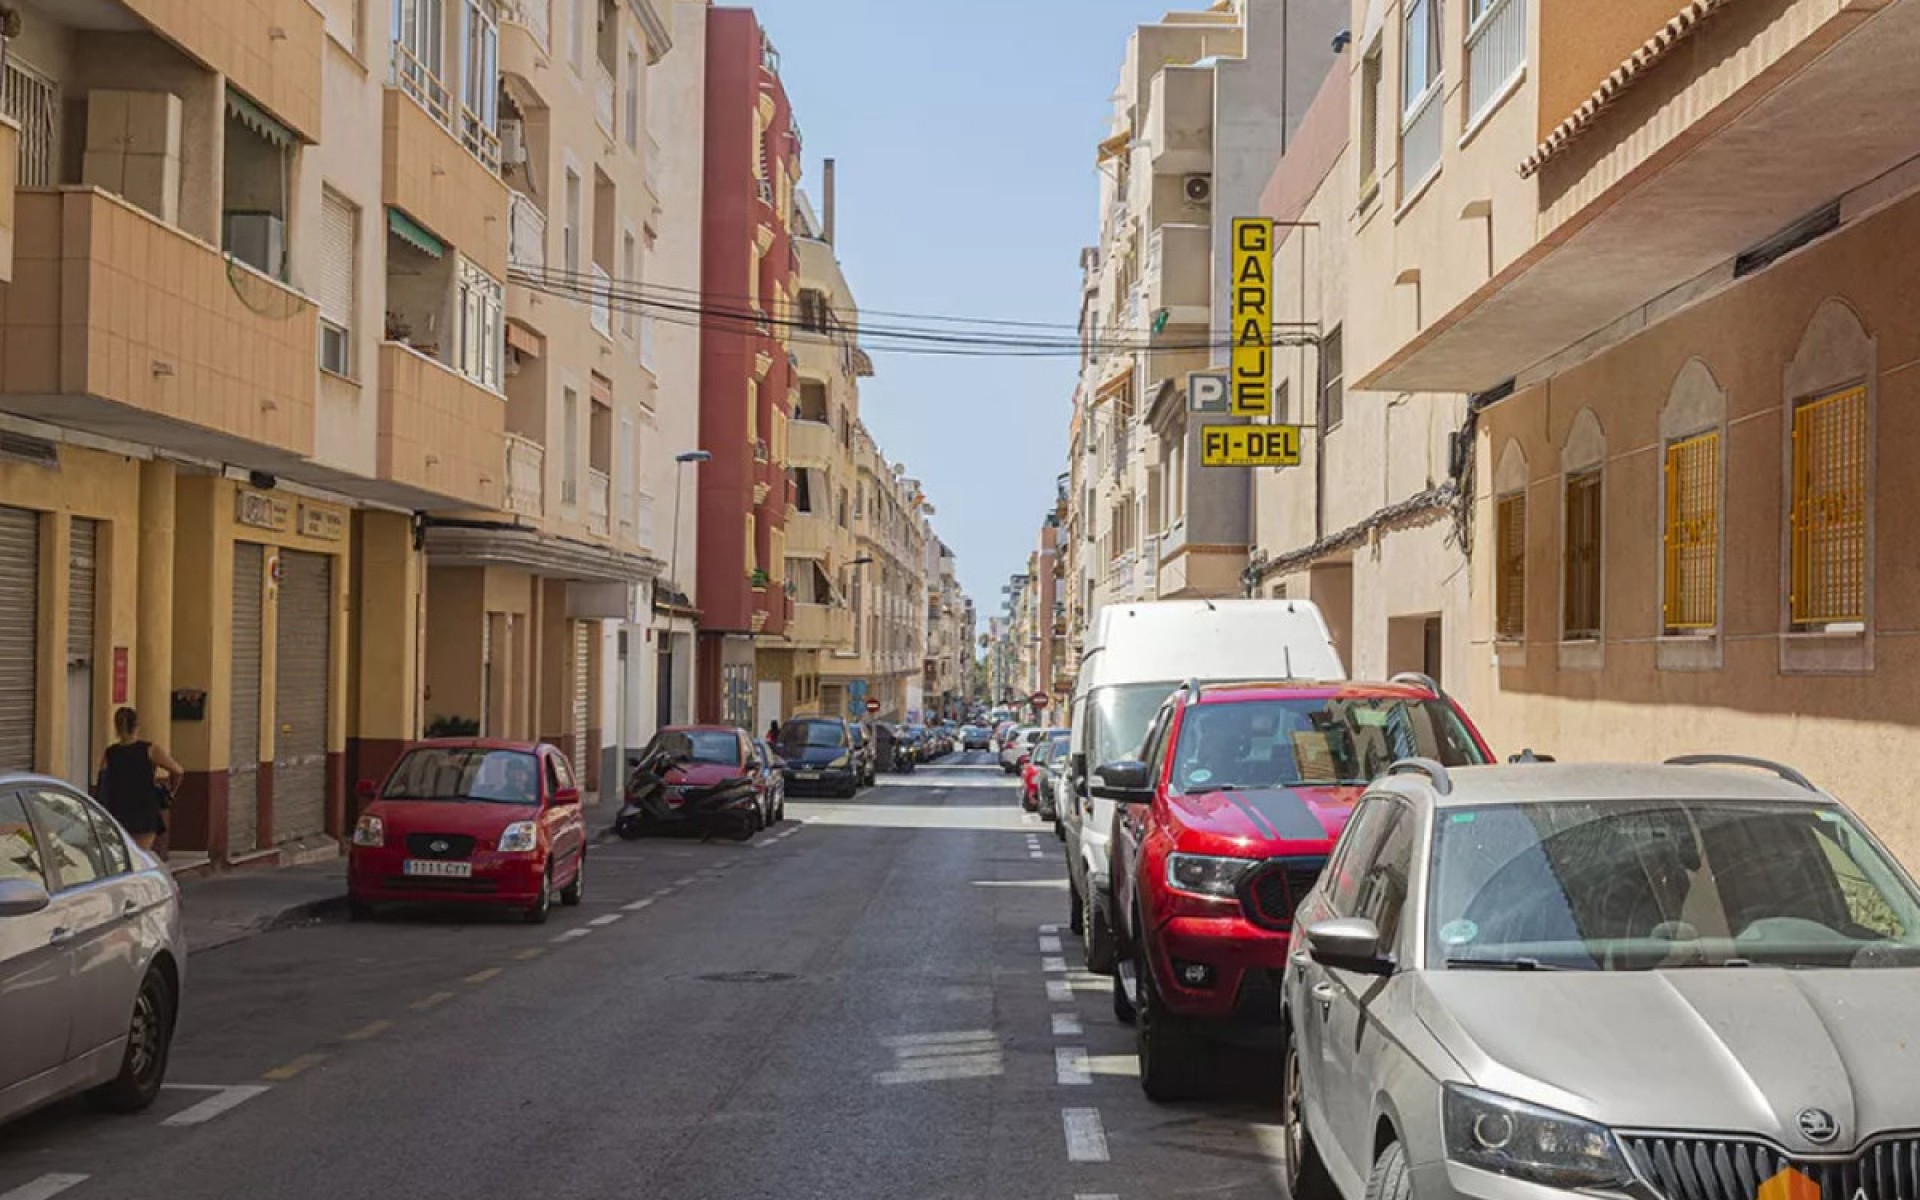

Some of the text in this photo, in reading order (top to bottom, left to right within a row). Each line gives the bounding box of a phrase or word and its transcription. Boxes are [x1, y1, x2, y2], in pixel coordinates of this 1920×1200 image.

[1238, 223, 1265, 411] GARAJE
[1194, 377, 1223, 409] P
[1206, 431, 1297, 457] FI-DEL
